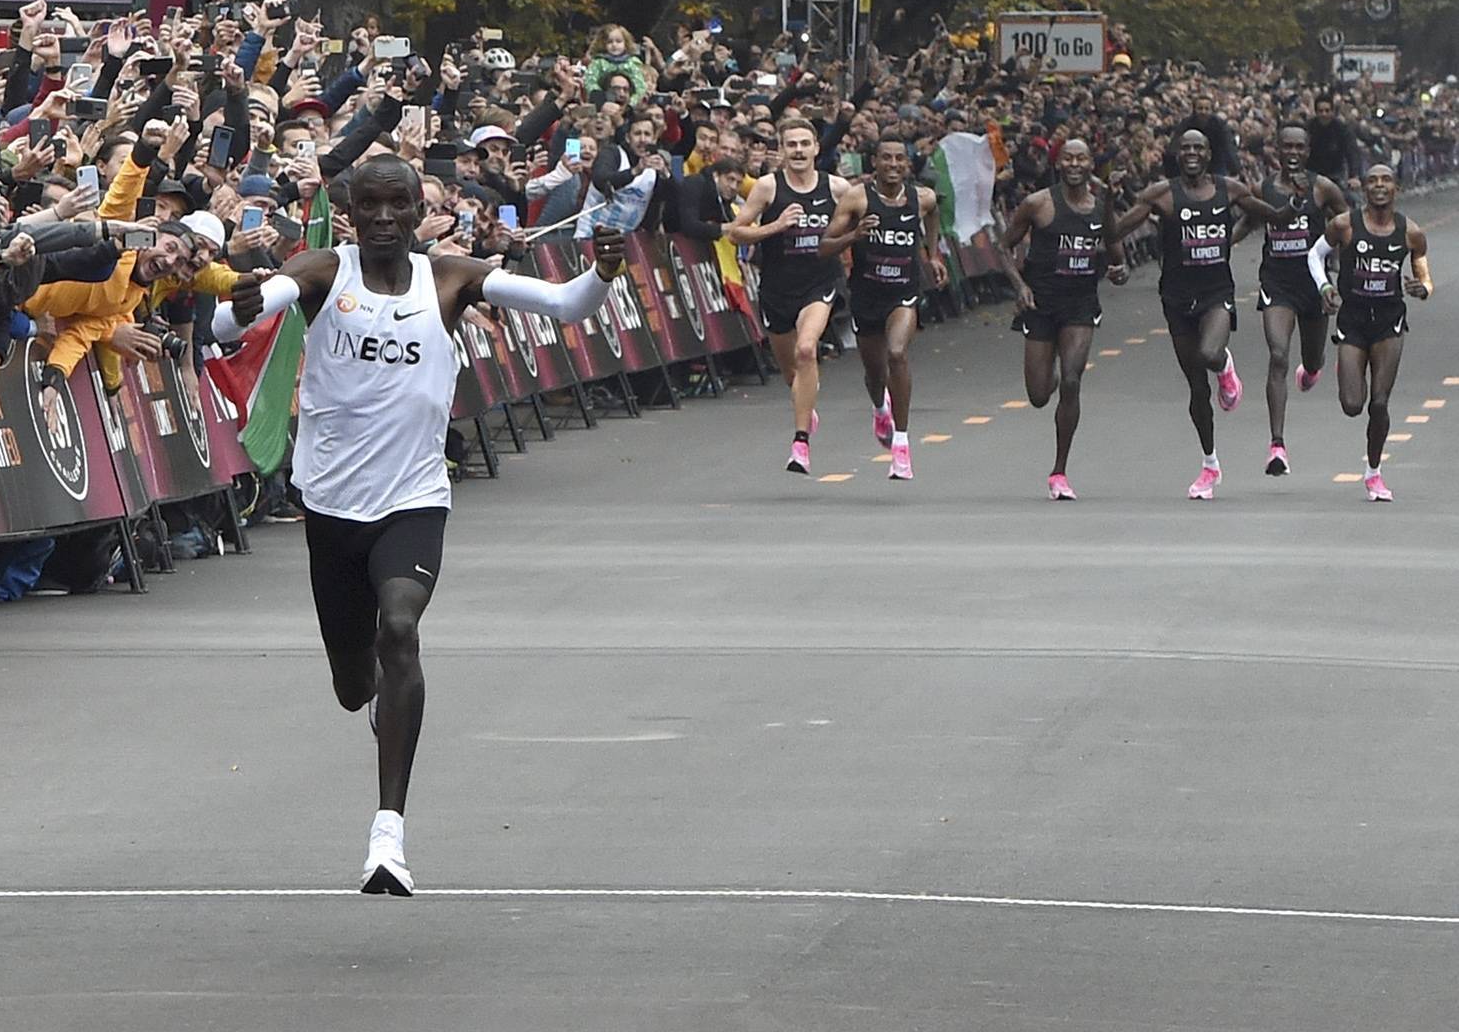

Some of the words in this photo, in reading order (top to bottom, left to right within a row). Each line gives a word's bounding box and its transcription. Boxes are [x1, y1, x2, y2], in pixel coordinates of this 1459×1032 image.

[1054, 38, 1069, 56] To
[1073, 37, 1093, 56] Go
[1182, 224, 1226, 240] INEOS
[333, 329, 421, 365] INEOS
